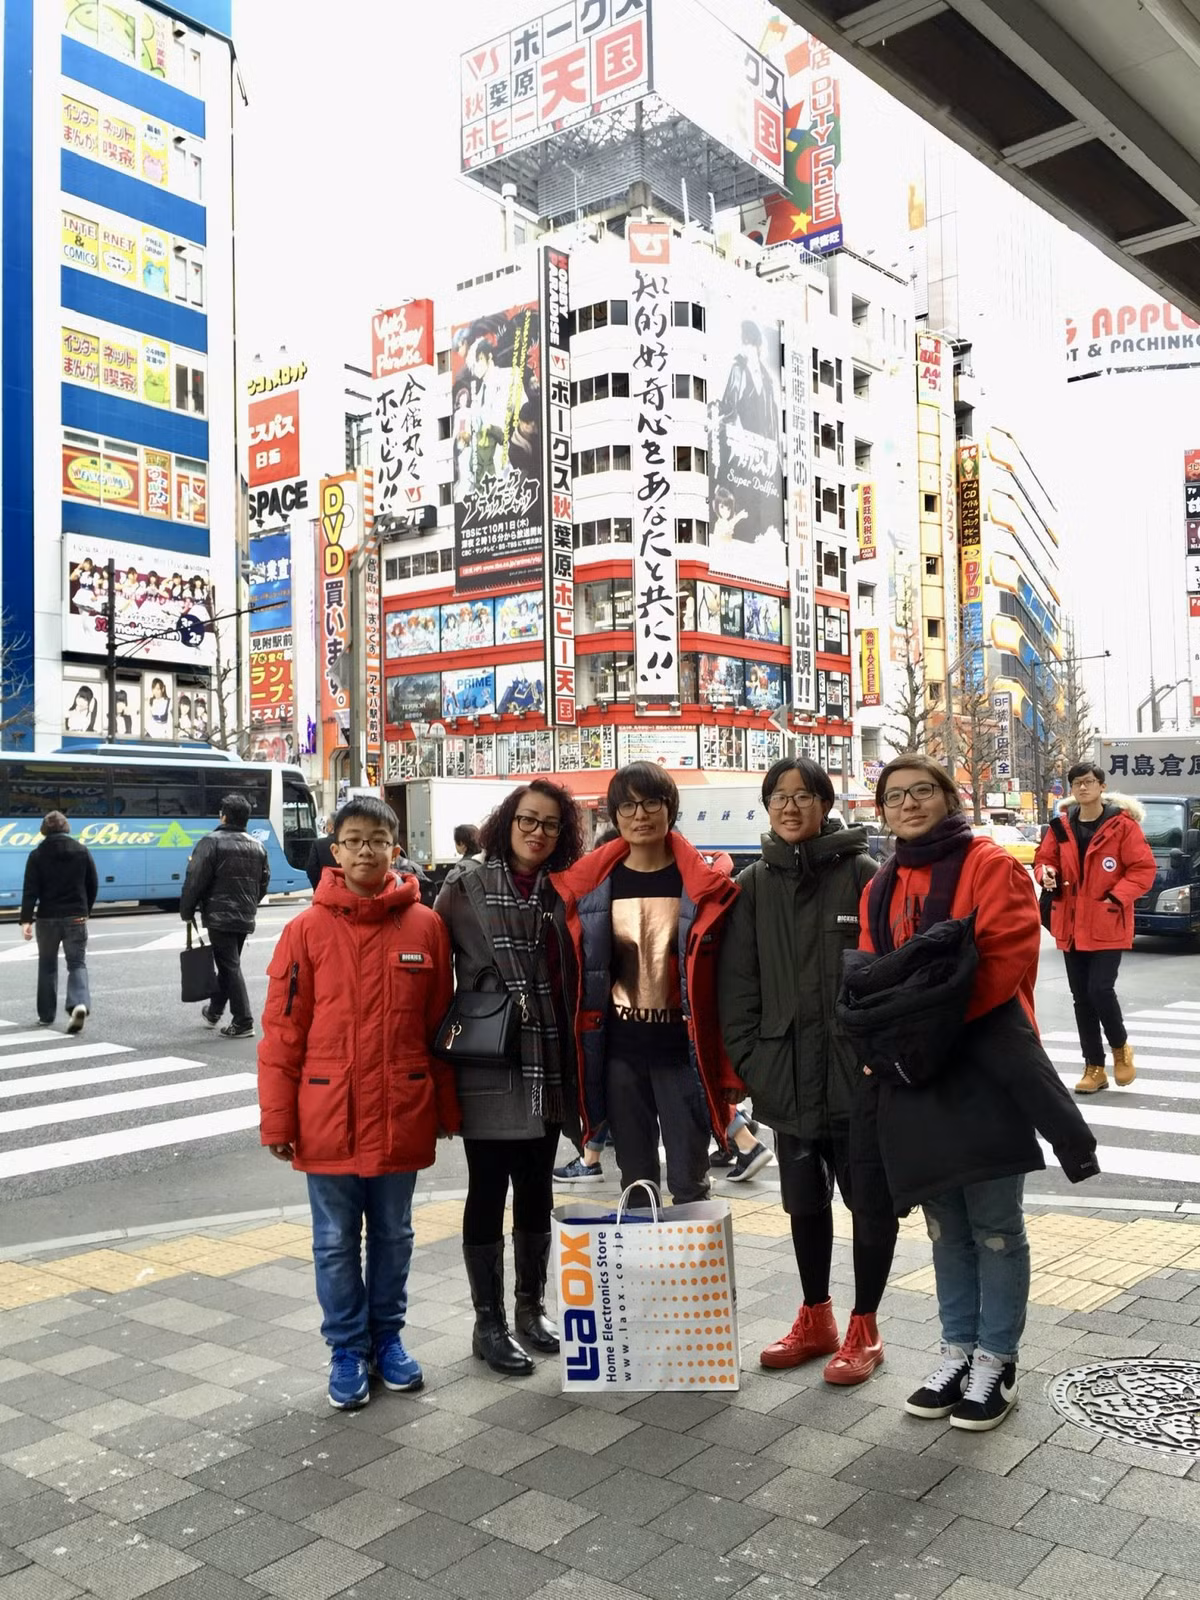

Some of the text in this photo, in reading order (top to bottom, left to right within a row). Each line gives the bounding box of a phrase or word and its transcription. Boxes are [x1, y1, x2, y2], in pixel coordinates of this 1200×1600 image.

[811, 76, 833, 145] DUTY
[812, 146, 835, 223] FREE
[74, 235, 84, 247] &
[63, 244, 97, 268] COMICS
[1087, 343, 1102, 358] &
[726, 468, 752, 488] Super
[963, 490, 977, 499] CD
[457, 676, 492, 690] PRIME
[78, 822, 156, 846] Bus
[596, 1231, 617, 1383] Home Electronics Store
